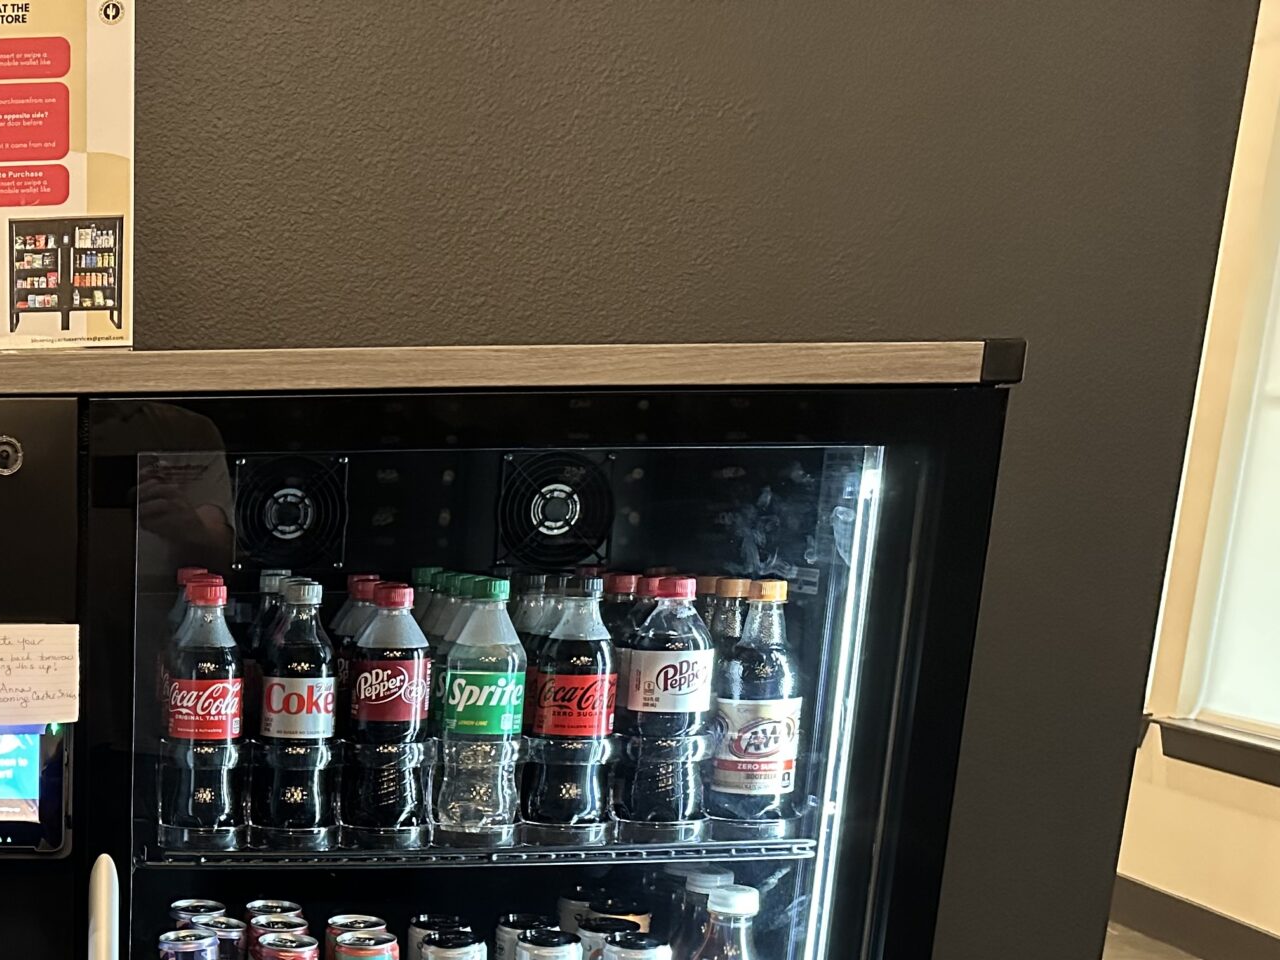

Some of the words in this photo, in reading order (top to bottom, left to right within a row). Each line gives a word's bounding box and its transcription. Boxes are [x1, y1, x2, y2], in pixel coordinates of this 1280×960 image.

[10, 3, 30, 12] THE
[17, 637, 45, 650] your
[11, 654, 32, 662] back
[682, 660, 698, 672] Dr
[370, 668, 392, 682] Dr
[360, 672, 404, 700] Pepper
[448, 678, 524, 712] Sprite
[538, 678, 618, 711] Coca-Cola
[170, 682, 242, 716] Coca-Cola
[265, 682, 335, 715] Coke
